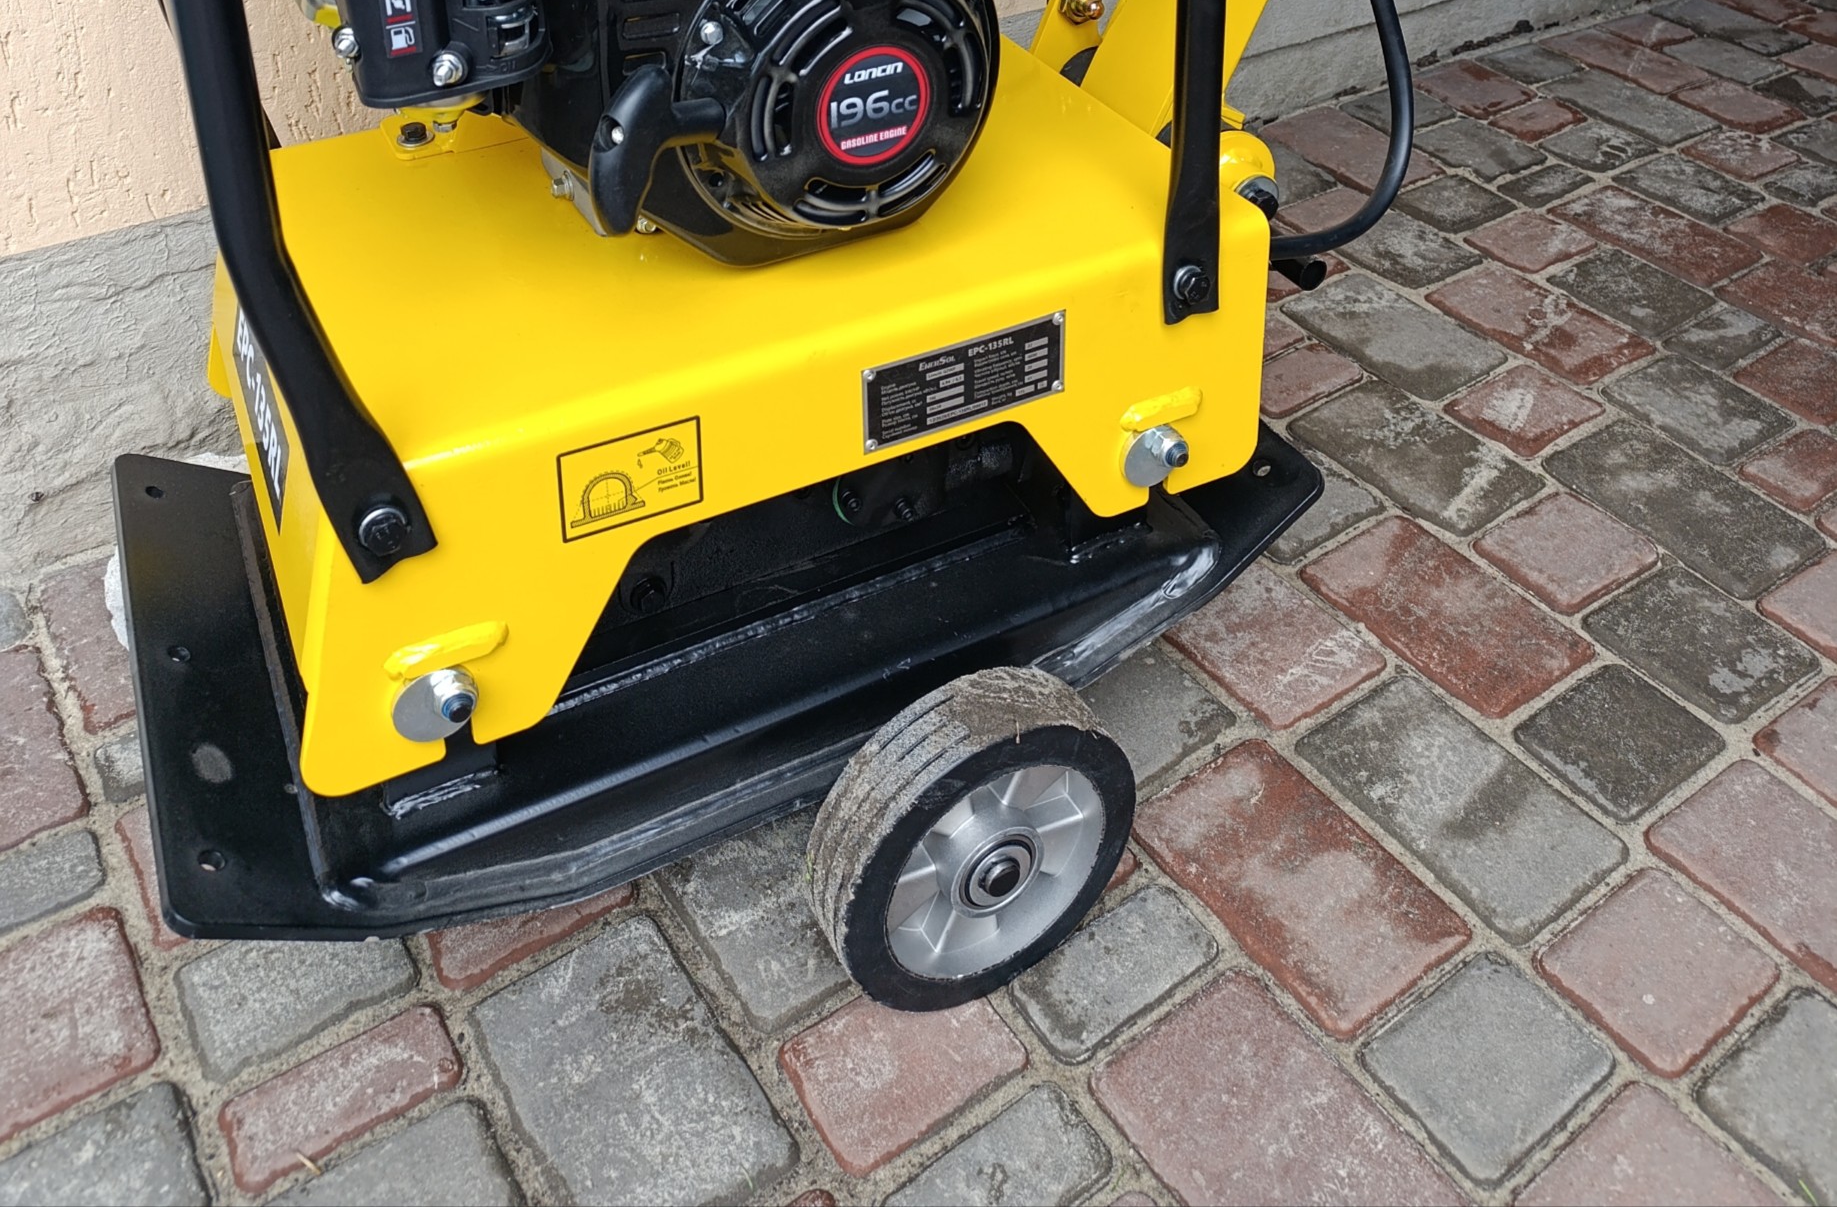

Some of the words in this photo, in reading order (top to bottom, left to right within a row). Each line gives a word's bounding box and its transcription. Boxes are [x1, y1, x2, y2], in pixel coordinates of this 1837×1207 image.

[830, 89, 918, 129] 196cc
[840, 133, 879, 151] GASOLINE
[879, 125, 908, 142] ENGINE
[968, 336, 1014, 357] EPC-135RL
[656, 467, 667, 475] Oil
[669, 460, 690, 472] Level!
